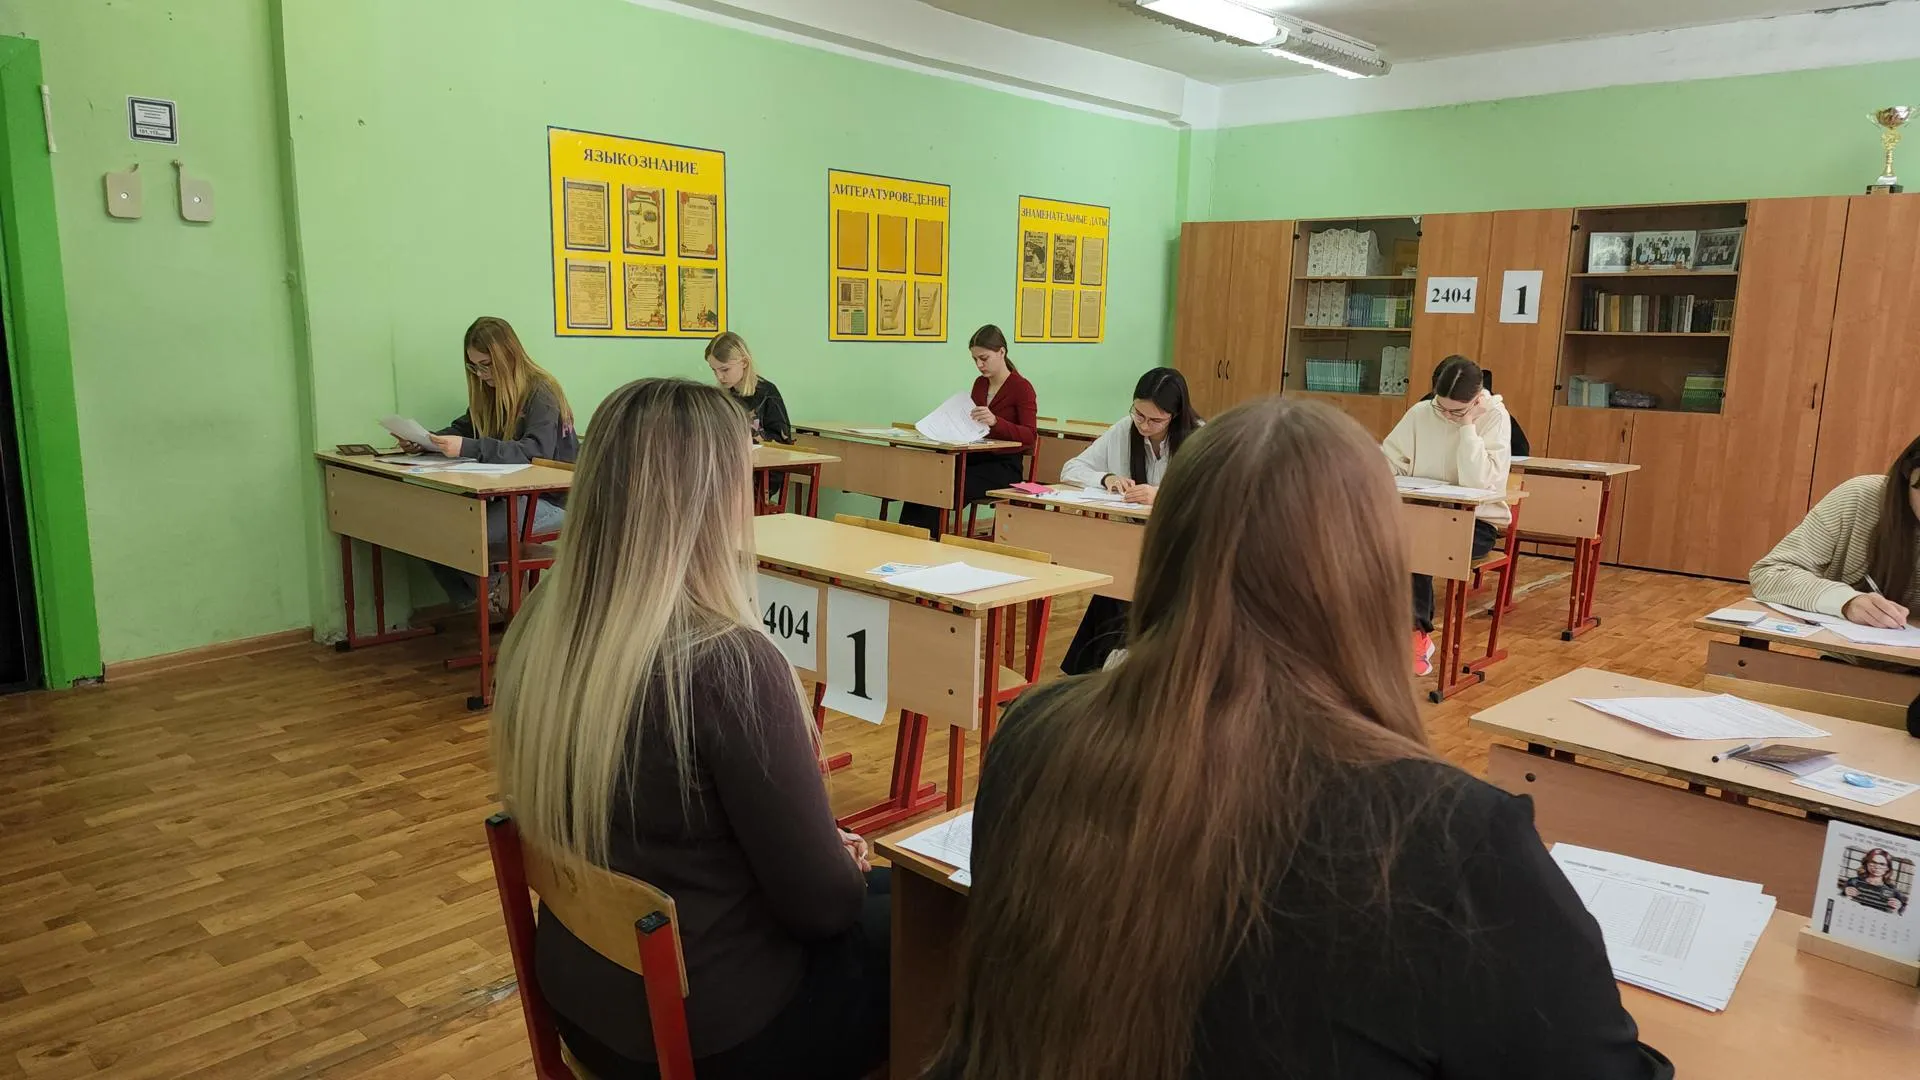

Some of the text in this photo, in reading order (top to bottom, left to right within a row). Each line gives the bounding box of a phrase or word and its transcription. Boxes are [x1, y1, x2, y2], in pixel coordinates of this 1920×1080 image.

[583, 148, 699, 175] ЯЗЫКОЗНАНИЕ
[832, 183, 947, 208] ЛИТЕРАТУРОВЕДЕНИЕ
[1021, 207, 1107, 226] ЗНАМЕНАТЕЛЬНЫЕ ДАТЫ
[1432, 288, 1471, 303] 2404
[1512, 285, 1528, 315] 1
[749, 597, 810, 644] 404
[846, 629, 872, 700] 1
